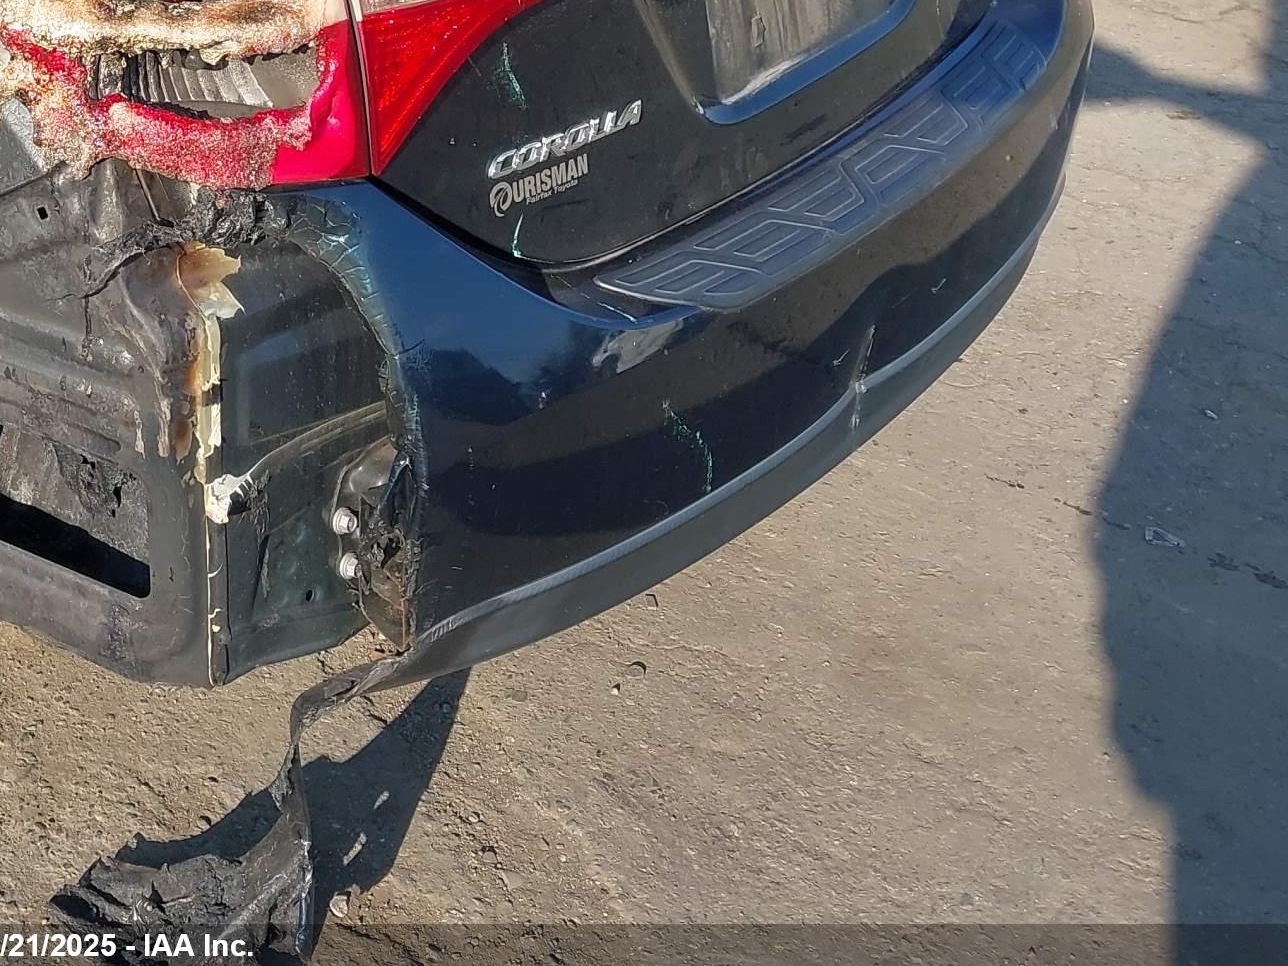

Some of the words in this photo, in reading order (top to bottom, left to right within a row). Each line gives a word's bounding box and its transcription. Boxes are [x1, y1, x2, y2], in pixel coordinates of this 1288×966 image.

[487, 99, 643, 180] COROLLA
[489, 153, 590, 218] OURISMAN
[553, 179, 579, 195] Toyota
